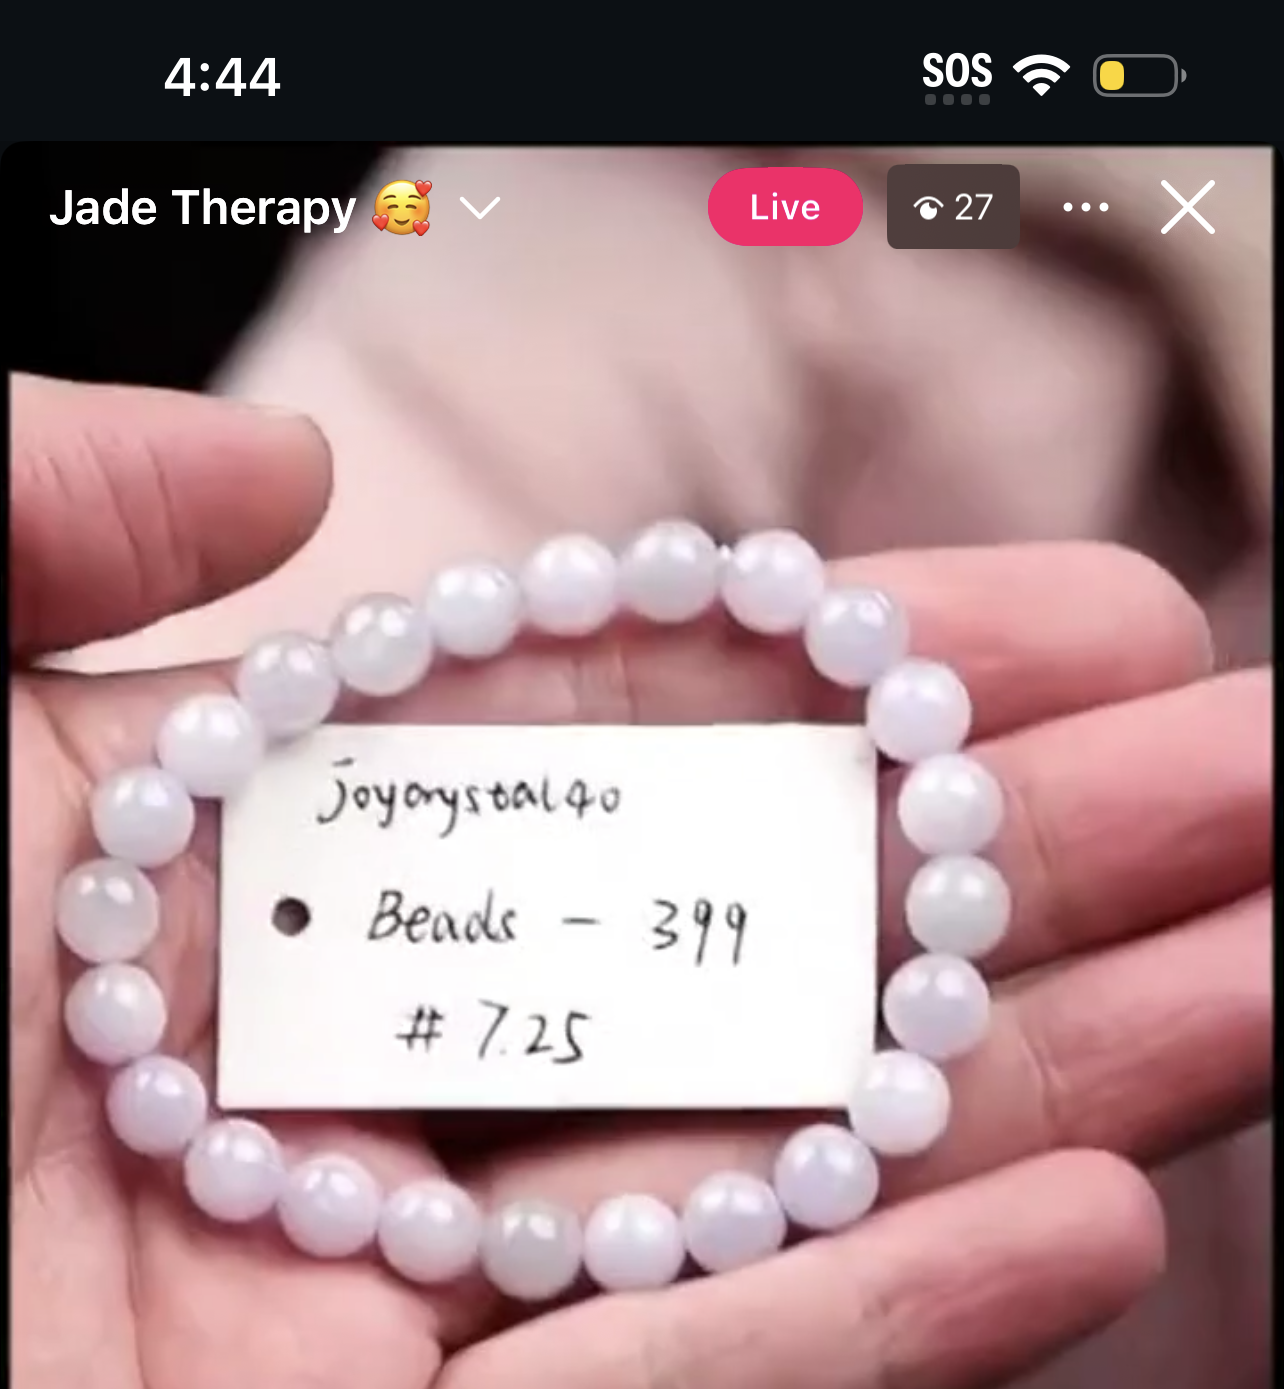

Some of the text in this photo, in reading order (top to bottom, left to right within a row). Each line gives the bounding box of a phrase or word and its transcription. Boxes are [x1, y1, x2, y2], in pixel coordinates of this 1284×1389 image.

[367, 890, 517, 944] Beads
[653, 899, 748, 965] 399
[396, 1000, 590, 1065] # 7.25
